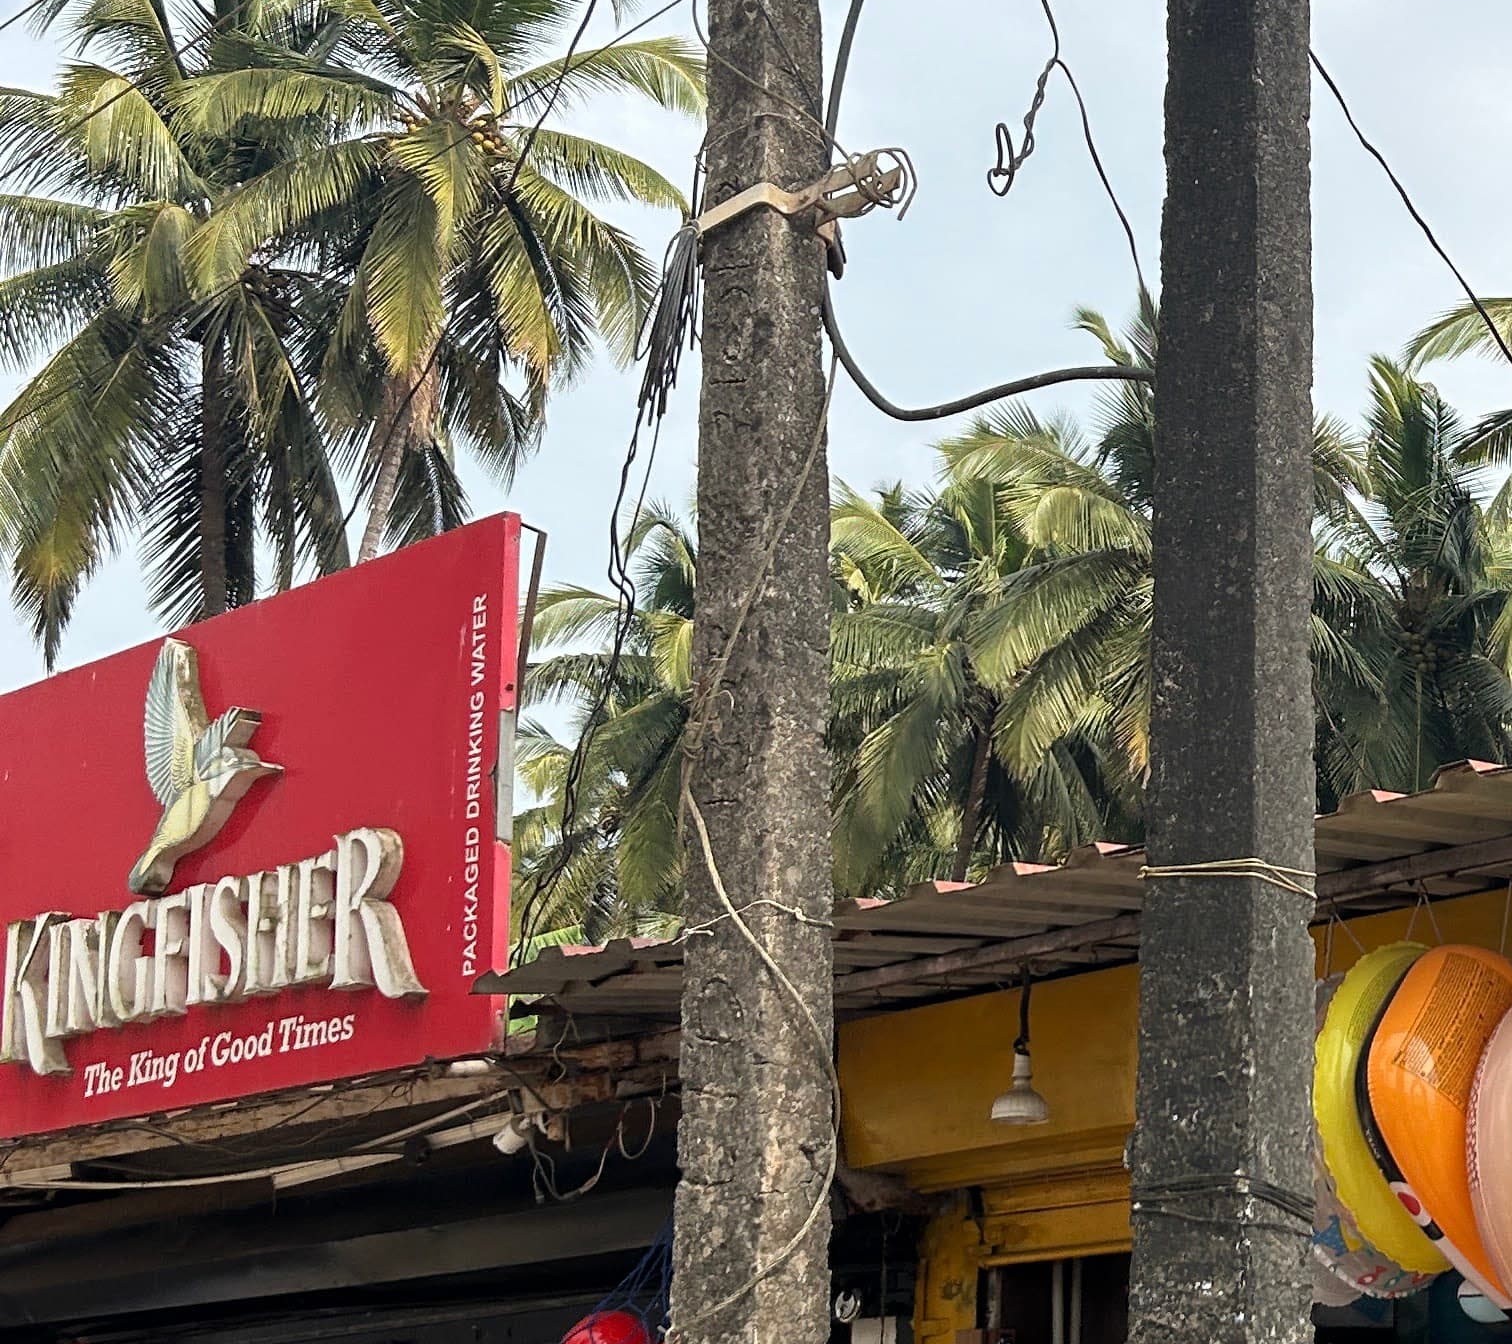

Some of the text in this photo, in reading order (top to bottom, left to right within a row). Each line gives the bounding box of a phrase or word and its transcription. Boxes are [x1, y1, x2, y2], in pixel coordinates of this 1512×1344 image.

[462, 592, 488, 977] PACKAGED DRINKING WATER
[0, 827, 430, 1077] KINGFISHER
[83, 1013, 356, 1098] The King of Good Times
